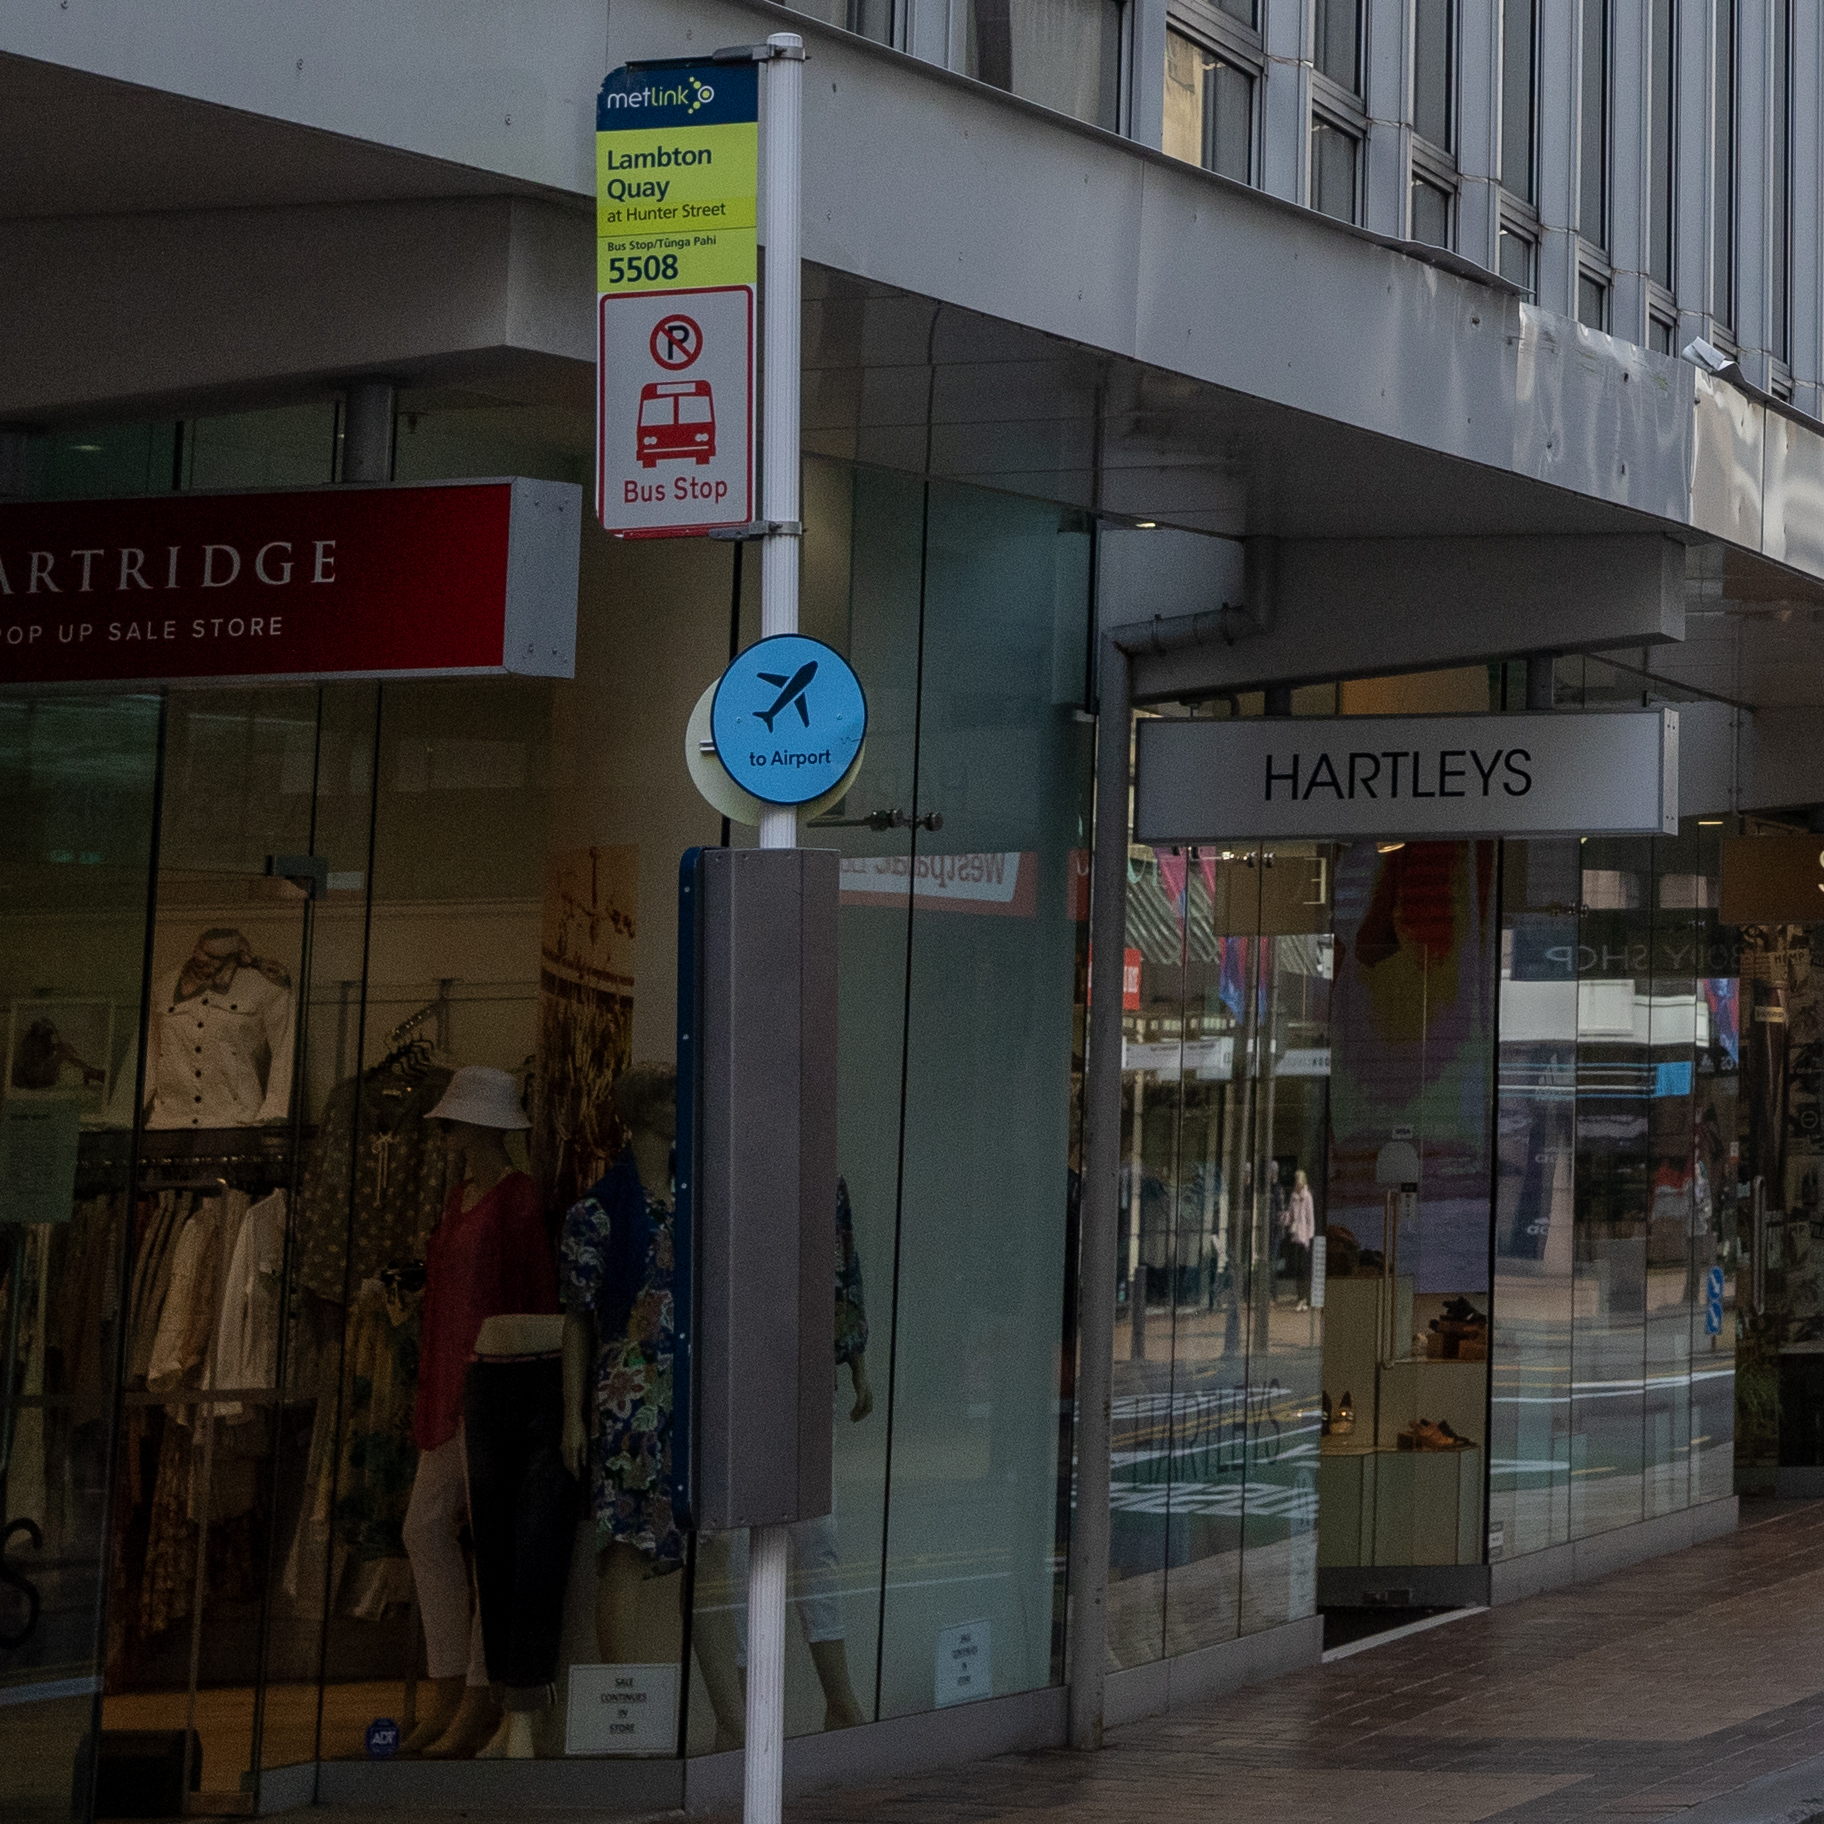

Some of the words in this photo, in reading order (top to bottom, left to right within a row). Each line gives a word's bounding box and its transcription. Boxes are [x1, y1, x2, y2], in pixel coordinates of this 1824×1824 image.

[607, 85, 689, 109] metlink
[607, 146, 712, 171] Lambton
[607, 178, 670, 203] Quay
[607, 209, 622, 223] at
[626, 206, 678, 222] Hunter
[682, 202, 726, 218] Street
[607, 242, 626, 252] Bus
[693, 235, 716, 246] Pahi
[609, 254, 679, 284] 5508
[623, 479, 666, 503] Bus
[673, 475, 728, 504] Stop
[0, 625, 43, 645] OP
[58, 623, 94, 643] UP
[108, 620, 177, 642] SALE
[191, 616, 283, 638] STORE
[749, 752, 767, 766] to
[770, 749, 831, 768] Airport
[1263, 747, 1534, 802] HARTLEYS
[370, 1730, 397, 1745] ADT
